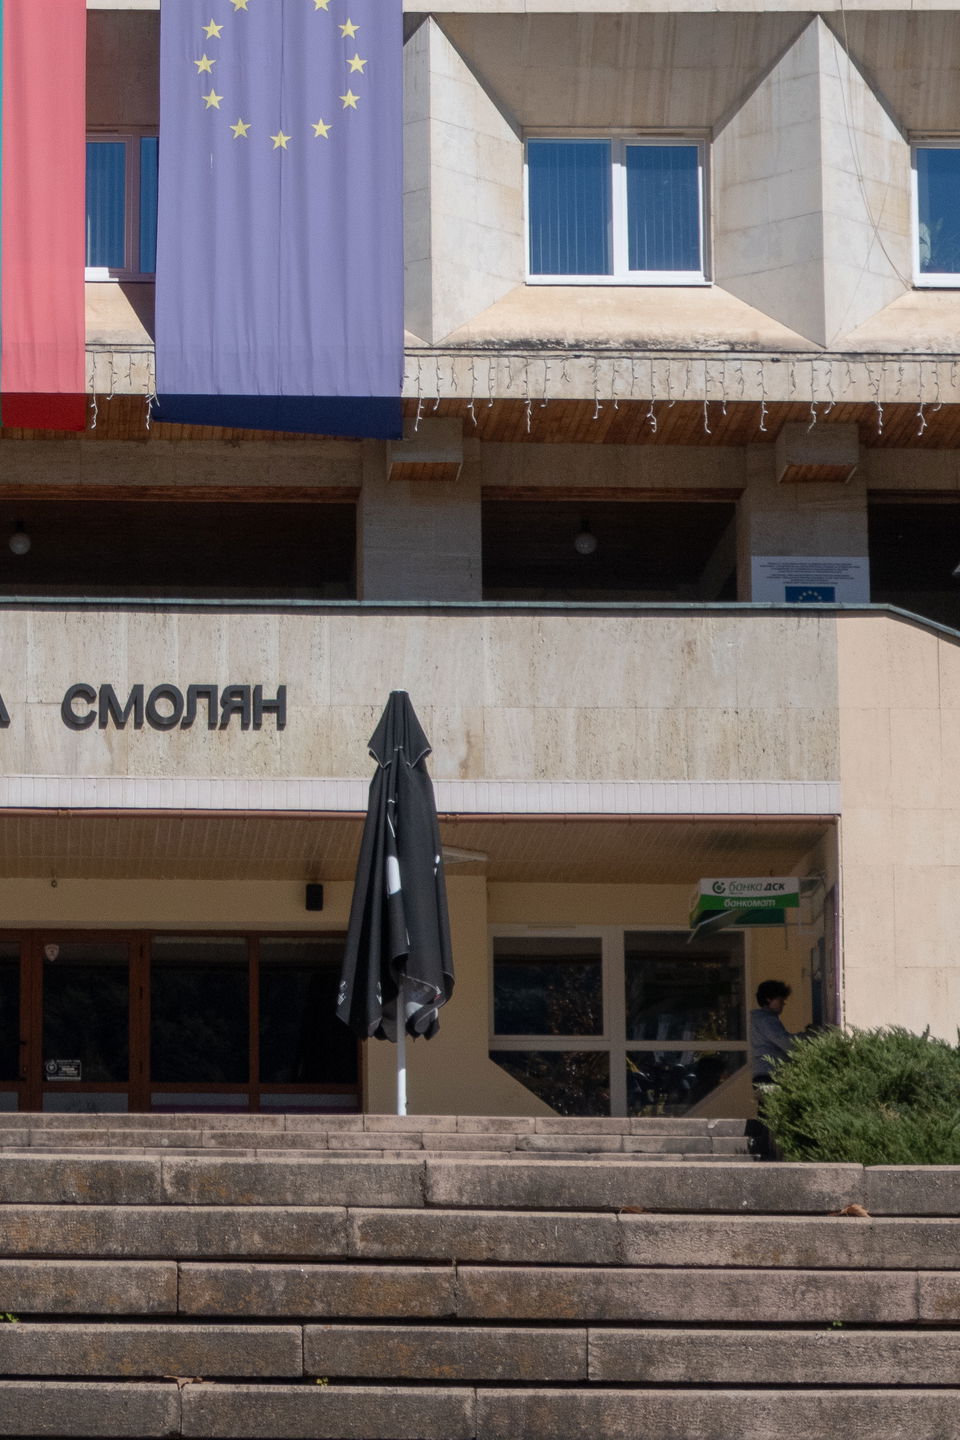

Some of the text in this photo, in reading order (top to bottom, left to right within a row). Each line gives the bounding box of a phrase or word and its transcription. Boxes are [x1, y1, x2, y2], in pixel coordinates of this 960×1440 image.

[61, 682, 287, 730] СМОЛЯН
[728, 881, 763, 891] банка
[724, 899, 776, 907] банкомат
